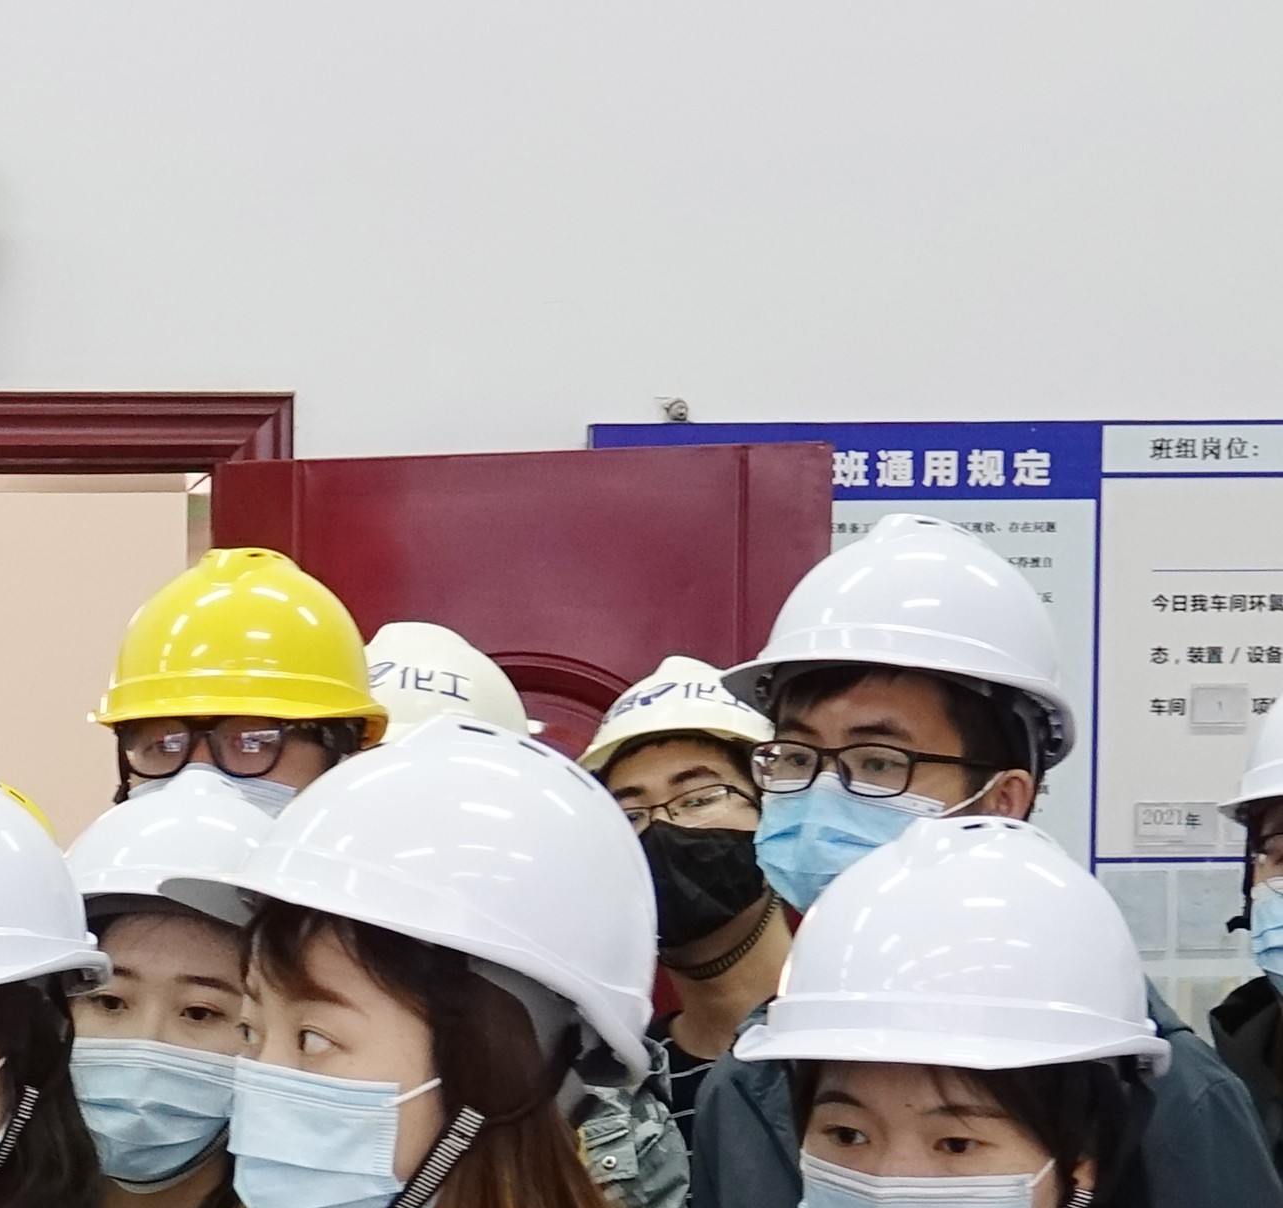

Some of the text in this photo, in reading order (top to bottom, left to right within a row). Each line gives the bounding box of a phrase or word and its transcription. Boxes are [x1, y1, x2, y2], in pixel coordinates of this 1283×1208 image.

[832, 449, 1052, 488] 班通用规定
[1149, 698, 1187, 716] 车间
